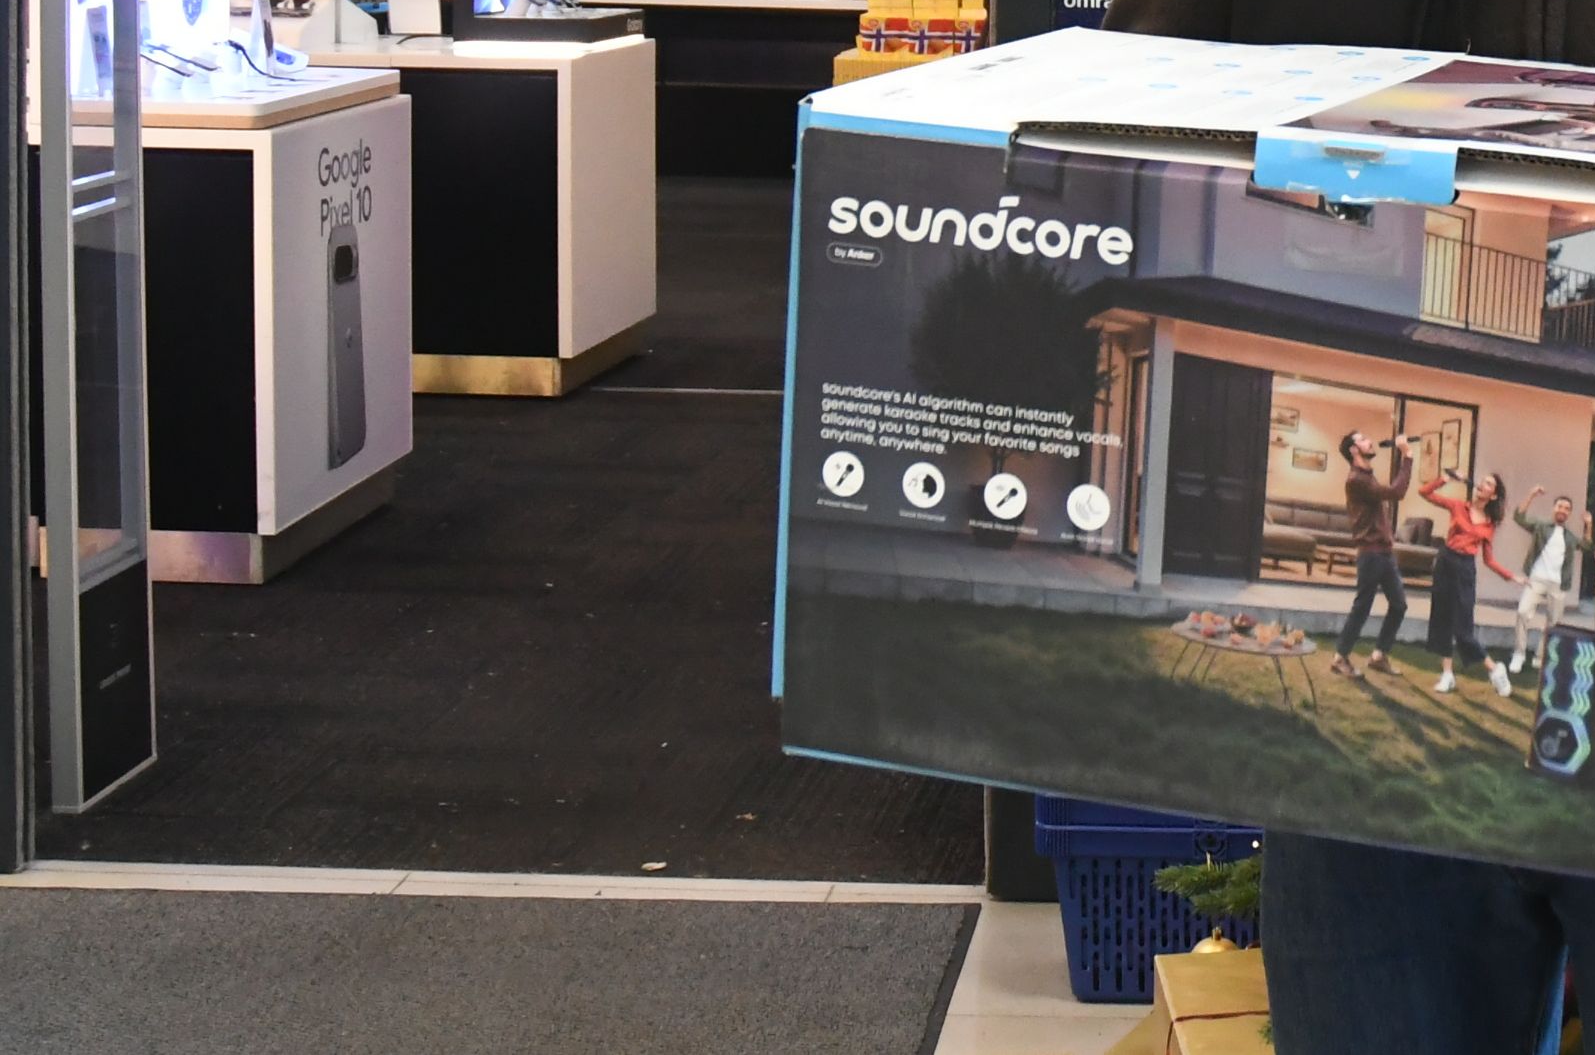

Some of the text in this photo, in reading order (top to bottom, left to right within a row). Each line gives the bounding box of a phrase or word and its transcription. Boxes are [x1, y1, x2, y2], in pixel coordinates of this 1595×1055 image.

[318, 138, 372, 188] Google
[320, 185, 372, 237] Pixel 10
[827, 196, 1134, 265] soundcore
[821, 398, 882, 416] generate
[884, 404, 938, 423] karaoke
[940, 413, 981, 428] tracks
[983, 418, 1011, 433] and
[1012, 422, 1074, 441] enhance
[822, 382, 1074, 427] soundcore's AI algorithm can instantly
[821, 413, 1080, 458] allowing you to sing your favorite songs
